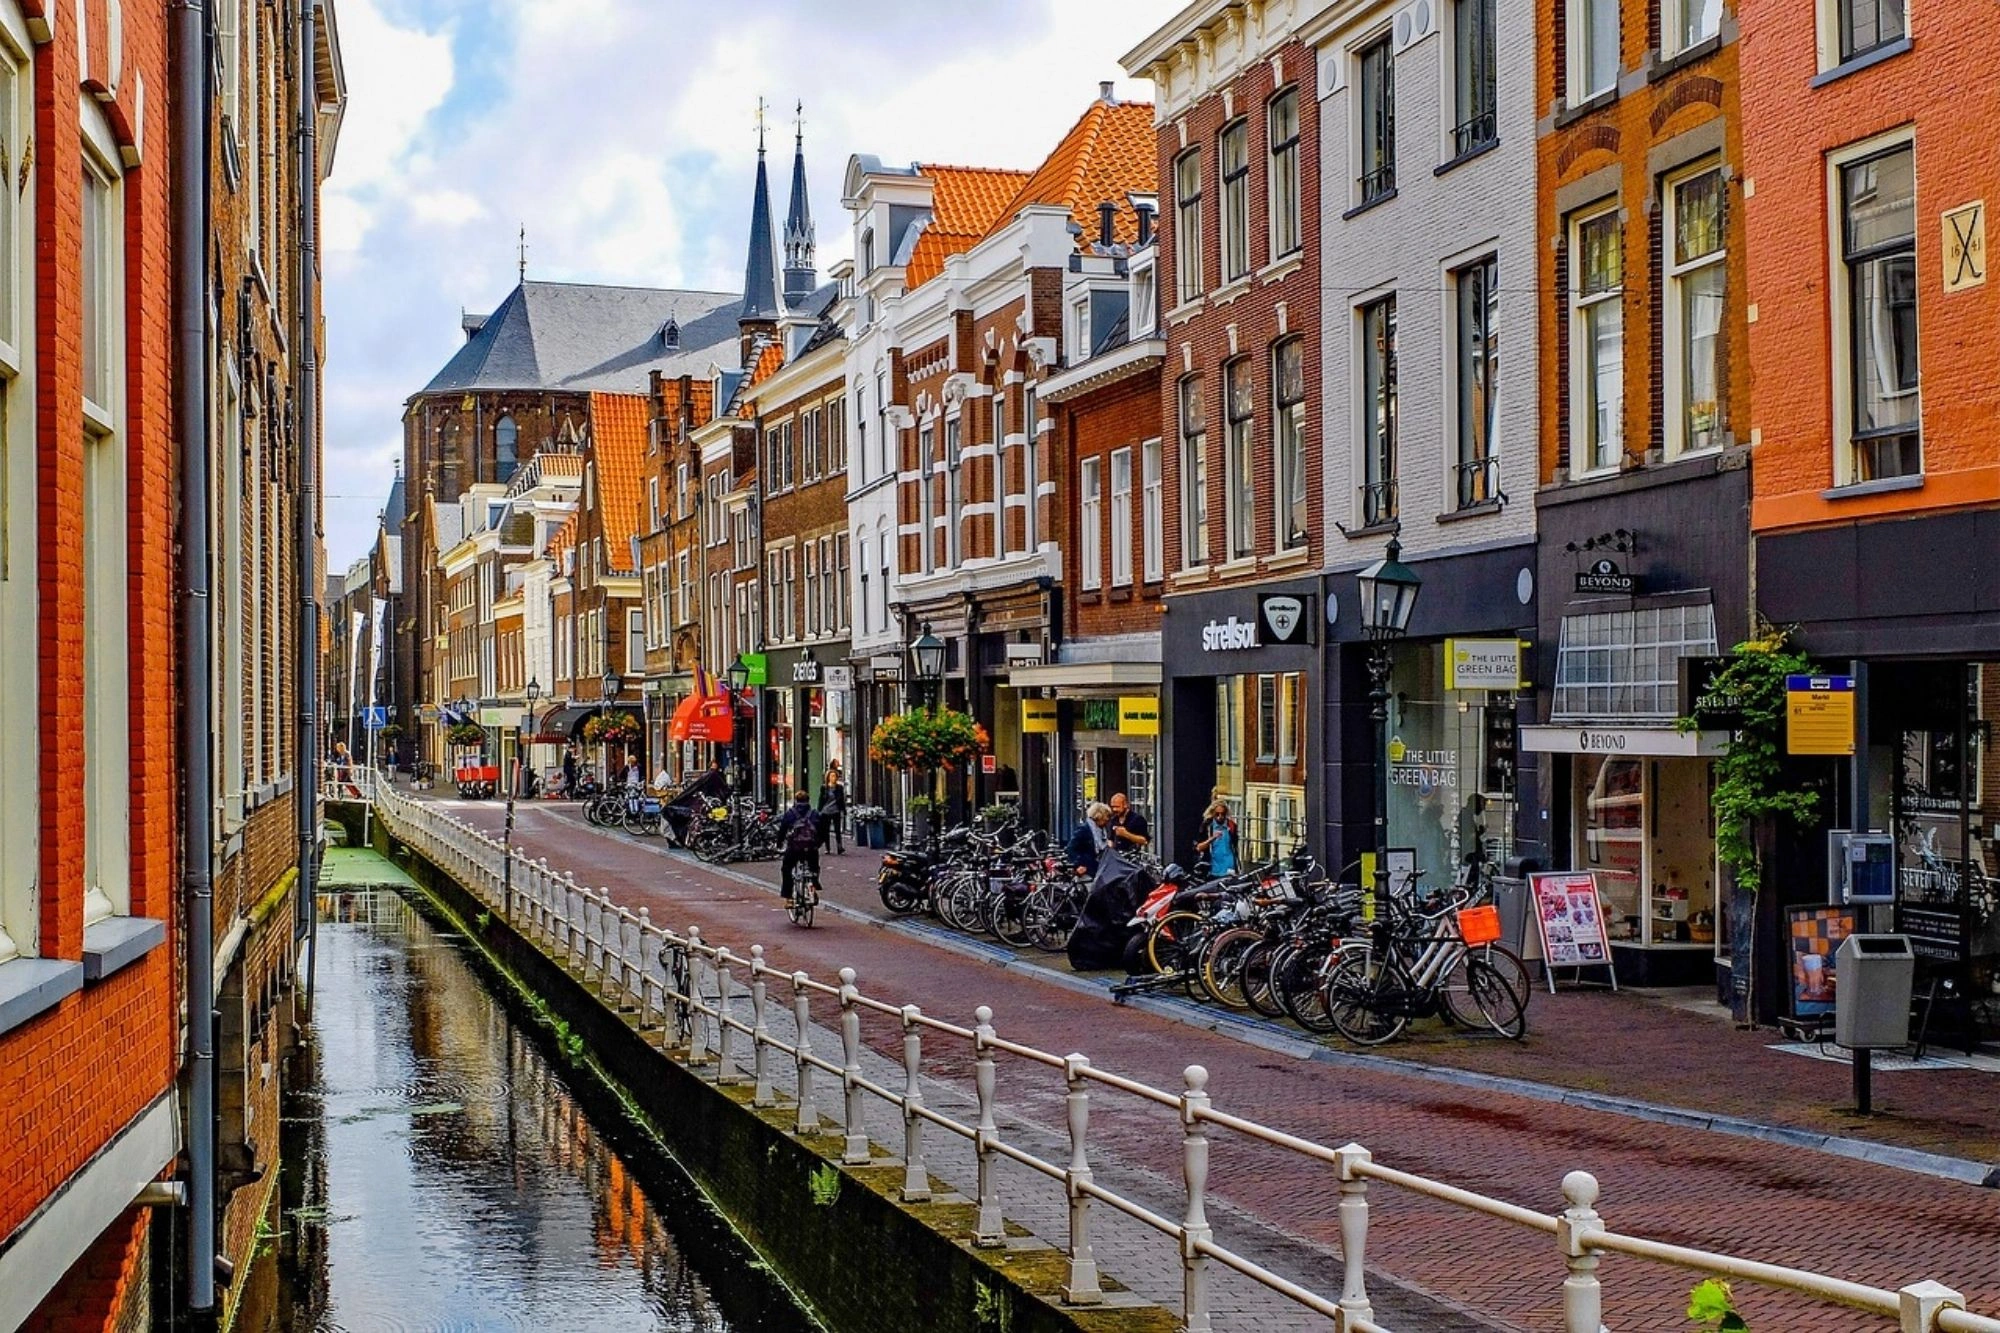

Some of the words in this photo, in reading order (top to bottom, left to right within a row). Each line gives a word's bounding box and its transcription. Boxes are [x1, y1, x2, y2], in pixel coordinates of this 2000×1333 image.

[1951, 244, 1960, 258] 16
[1971, 237, 1981, 252] 41
[1580, 576, 1632, 588] BEYOND
[1471, 655, 1487, 663] THE
[1490, 655, 1517, 663] LITTLE
[1456, 664, 1492, 674] GREEN
[1495, 664, 1517, 674] BAG
[1591, 734, 1626, 749] BEYOND
[1405, 750, 1424, 763] THE
[1426, 750, 1457, 764] LITTLE
[1390, 768, 1429, 785] GREEN
[1431, 769, 1457, 787] BAG
